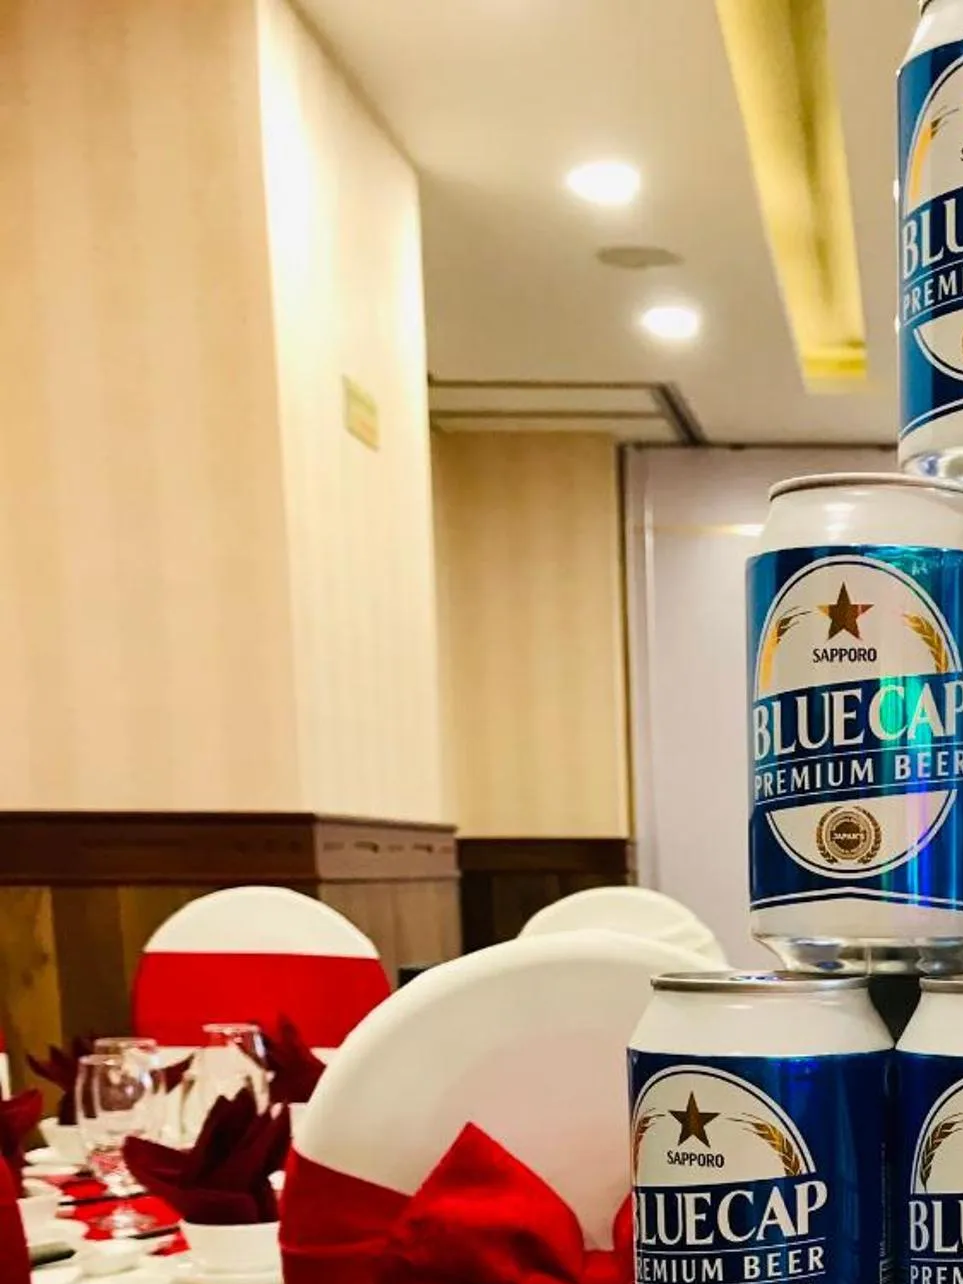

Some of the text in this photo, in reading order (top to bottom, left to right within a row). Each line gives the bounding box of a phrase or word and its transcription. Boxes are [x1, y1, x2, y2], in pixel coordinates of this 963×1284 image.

[812, 648, 877, 663] SAPPORO
[755, 759, 874, 800] PREMIUM
[667, 1149, 724, 1168] SAPPORO
[634, 1179, 828, 1246] LUECAP
[744, 1247, 825, 1281] BEER
